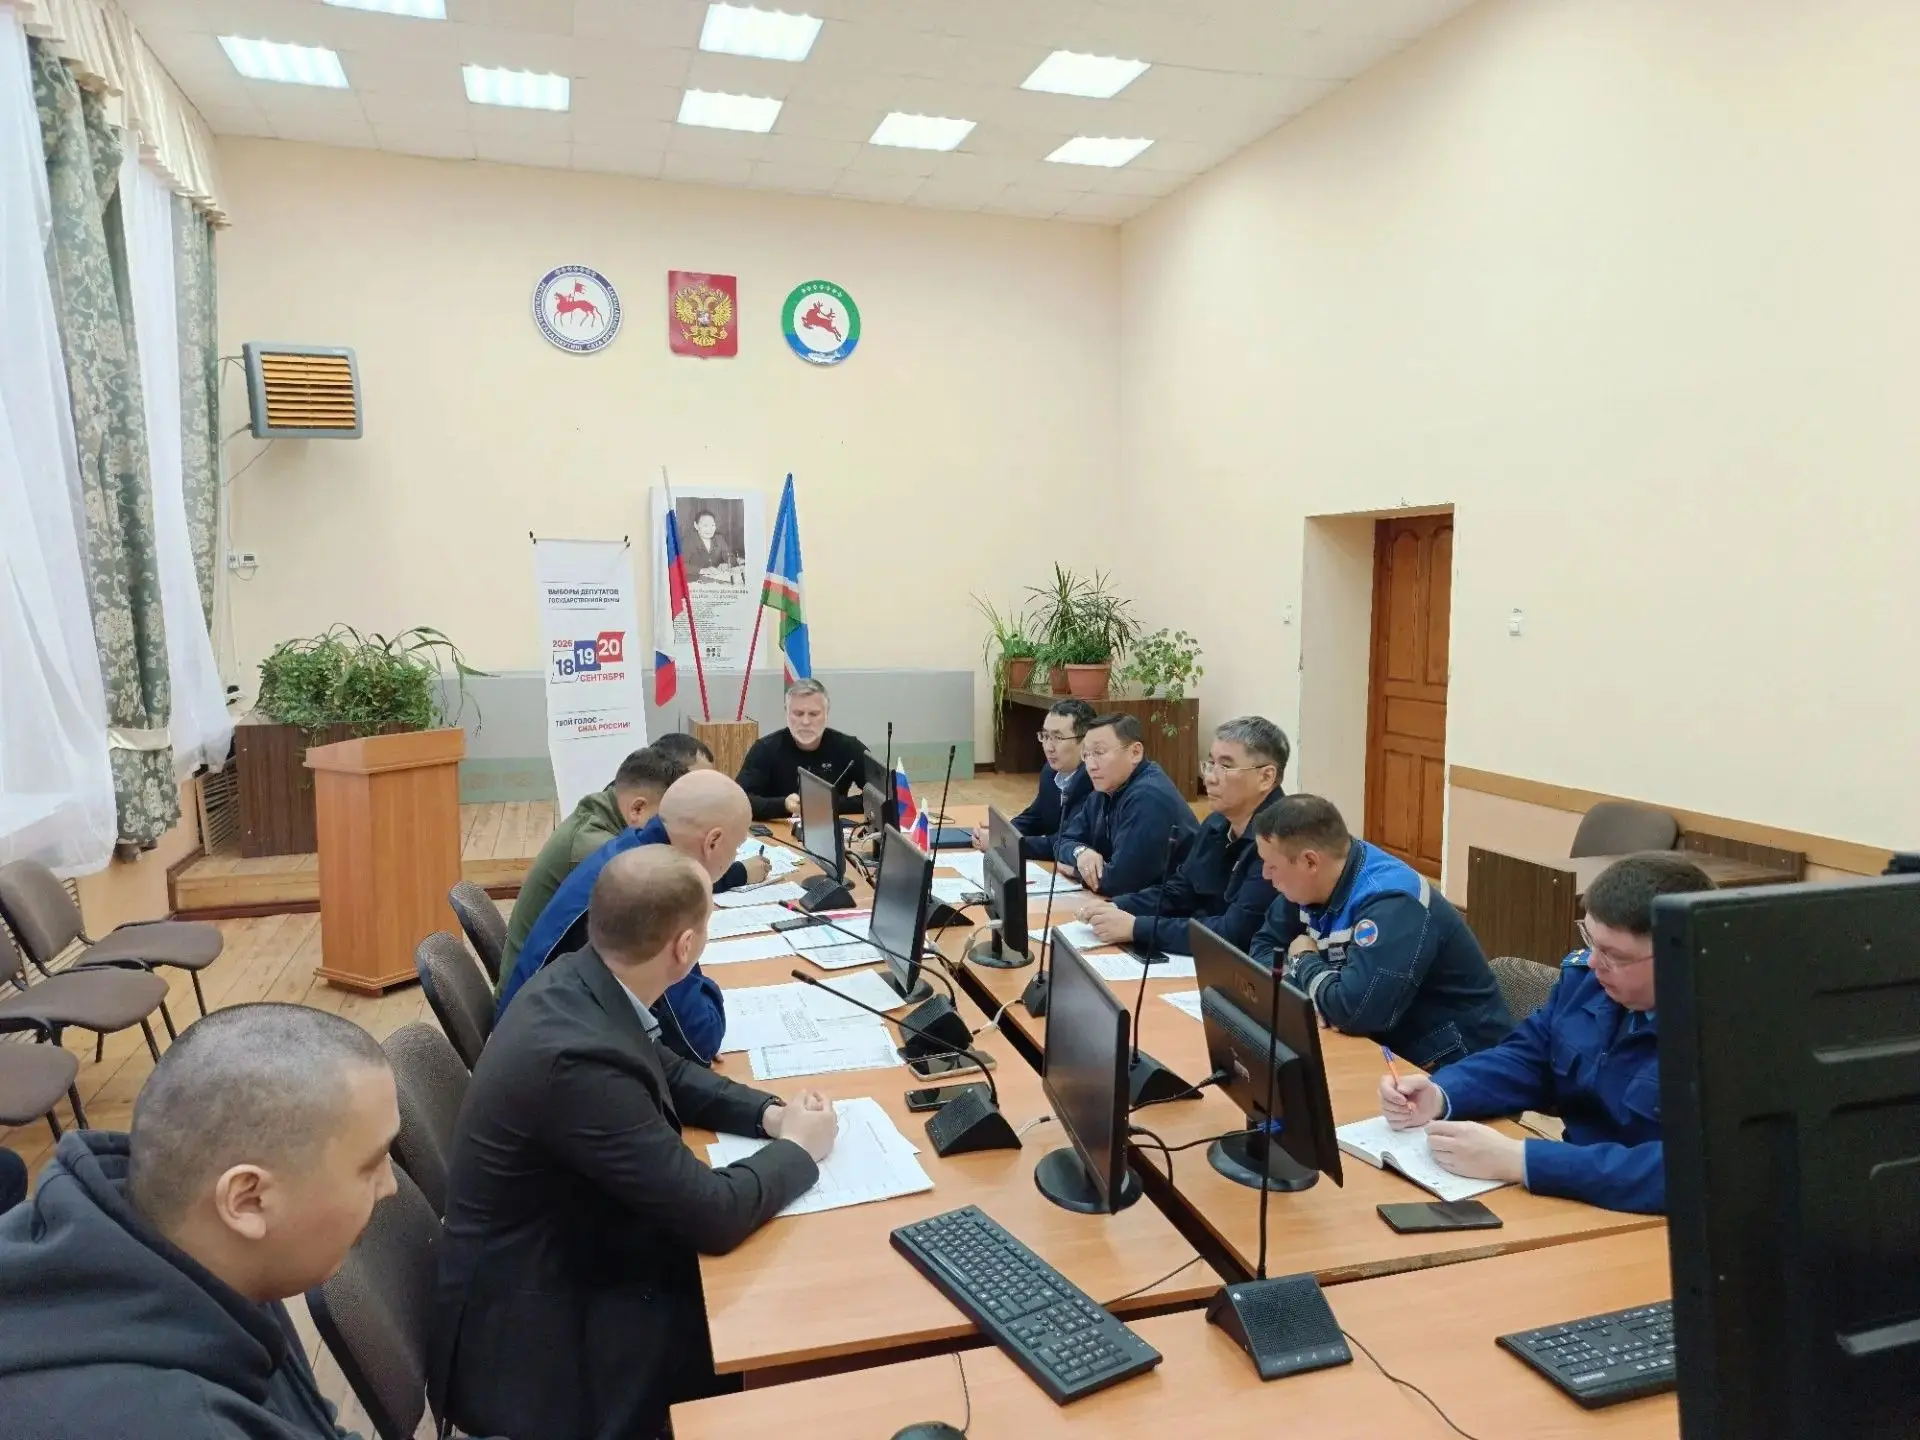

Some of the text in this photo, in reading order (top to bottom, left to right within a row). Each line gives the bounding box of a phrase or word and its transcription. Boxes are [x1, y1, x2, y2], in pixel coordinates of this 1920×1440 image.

[552, 640, 573, 648] 2026
[556, 639, 620, 676] 18 19 20
[580, 672, 625, 682] СЕНТЯБРЯ
[555, 718, 573, 727] ТВОЙ
[574, 717, 597, 725] ГОЛОС
[577, 721, 631, 732] СИЛА РОССИИ!
